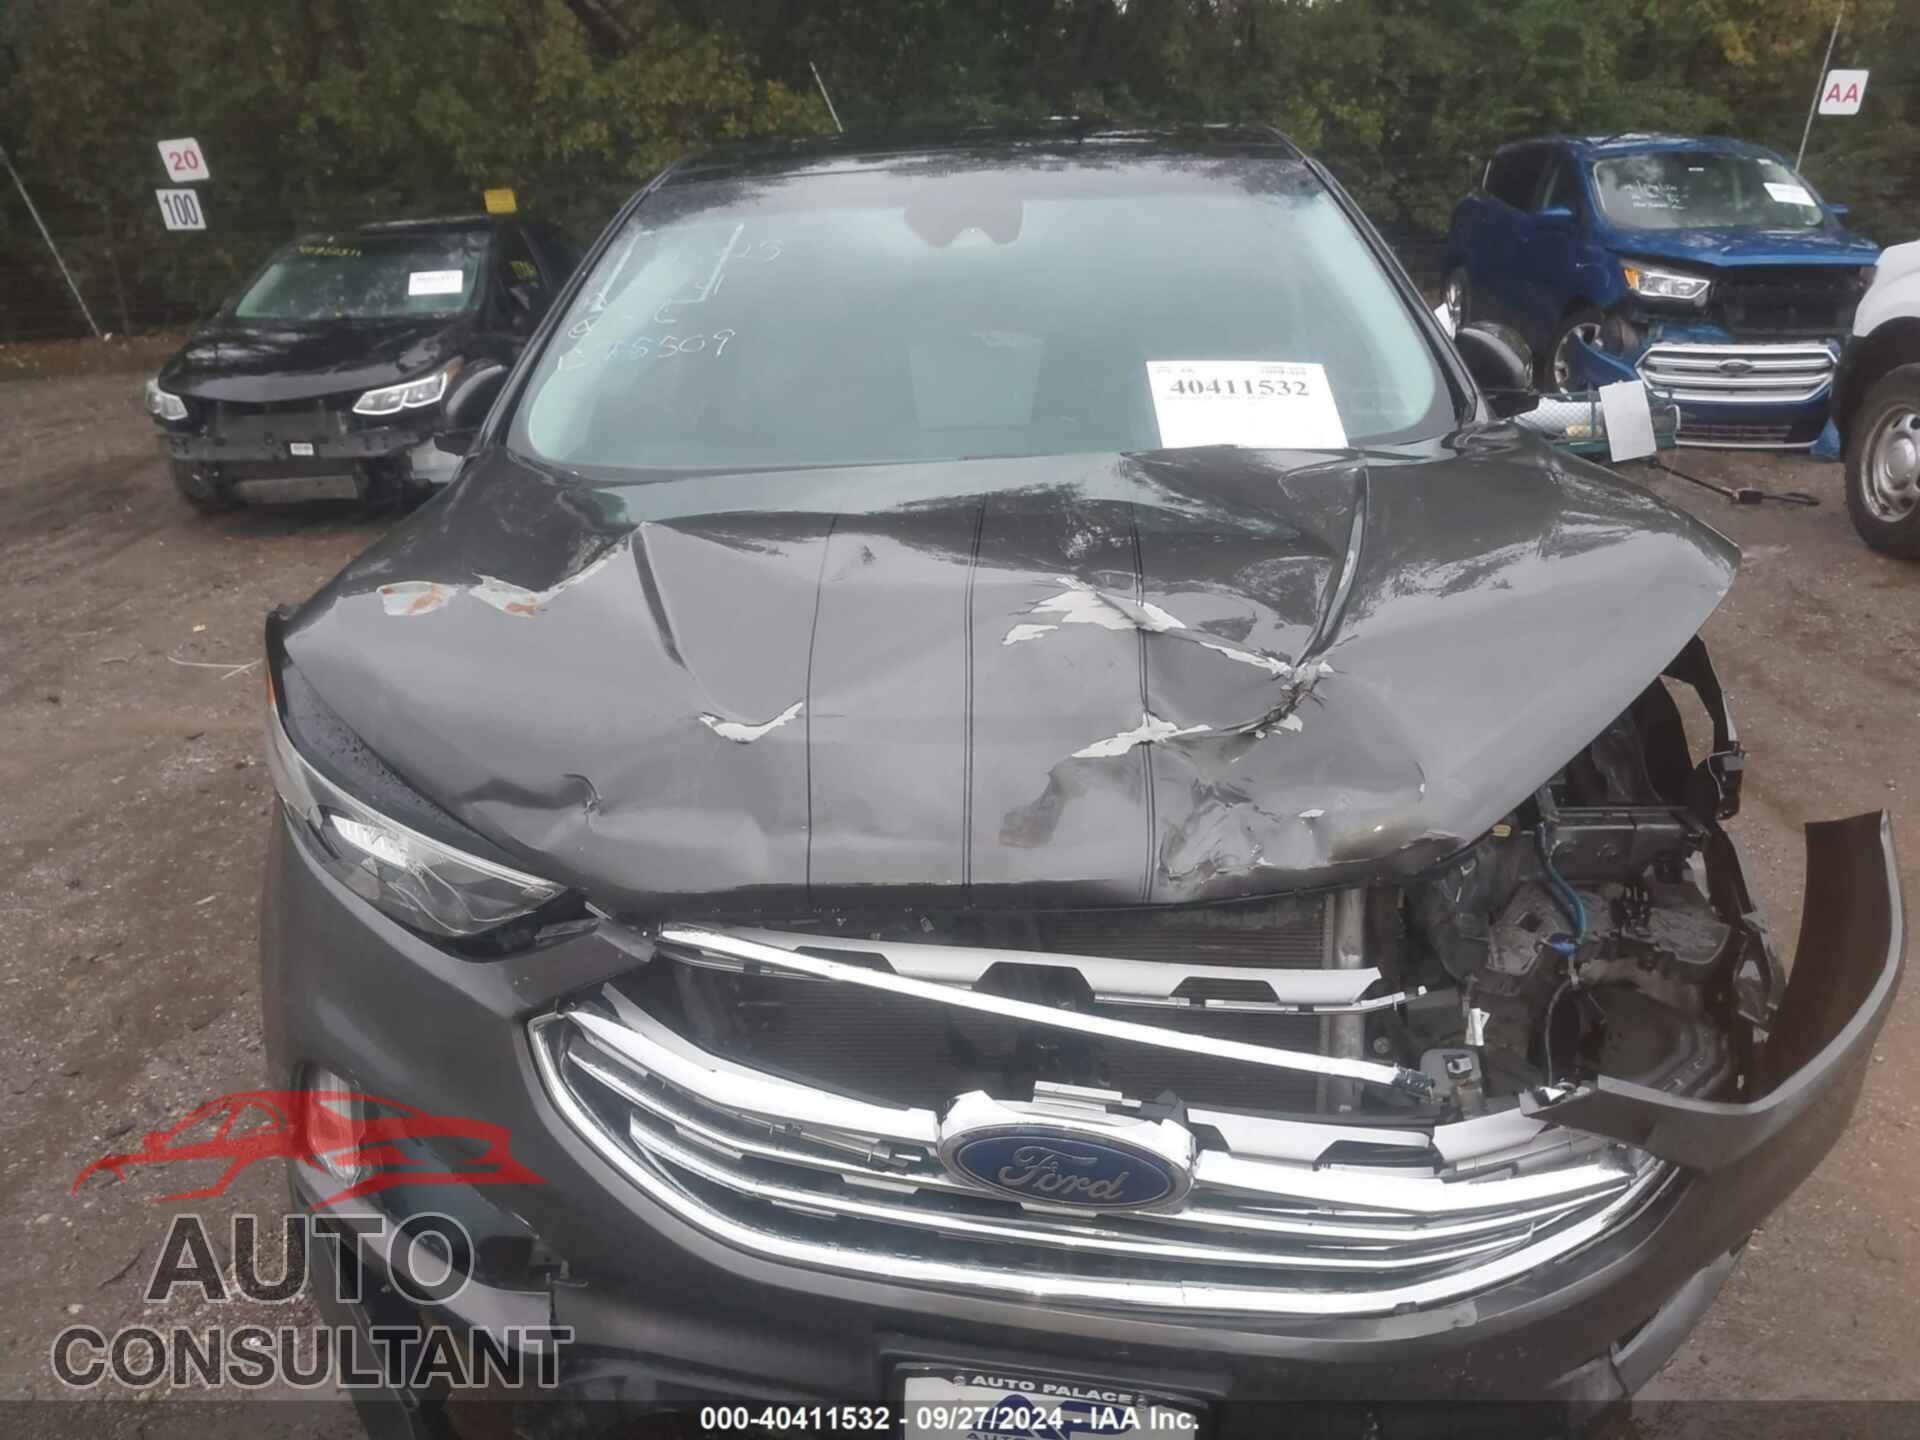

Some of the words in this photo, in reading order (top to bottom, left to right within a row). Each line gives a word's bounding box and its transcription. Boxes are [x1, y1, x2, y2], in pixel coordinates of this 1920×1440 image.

[1825, 83, 1857, 103] AA
[168, 150, 199, 171] 20
[164, 193, 199, 226] 100
[1169, 379, 1310, 397] 40411532
[1000, 1146, 1130, 1199] Ford
[971, 1375, 1036, 1391] AUTO
[1043, 1384, 1133, 1404] PALACE
